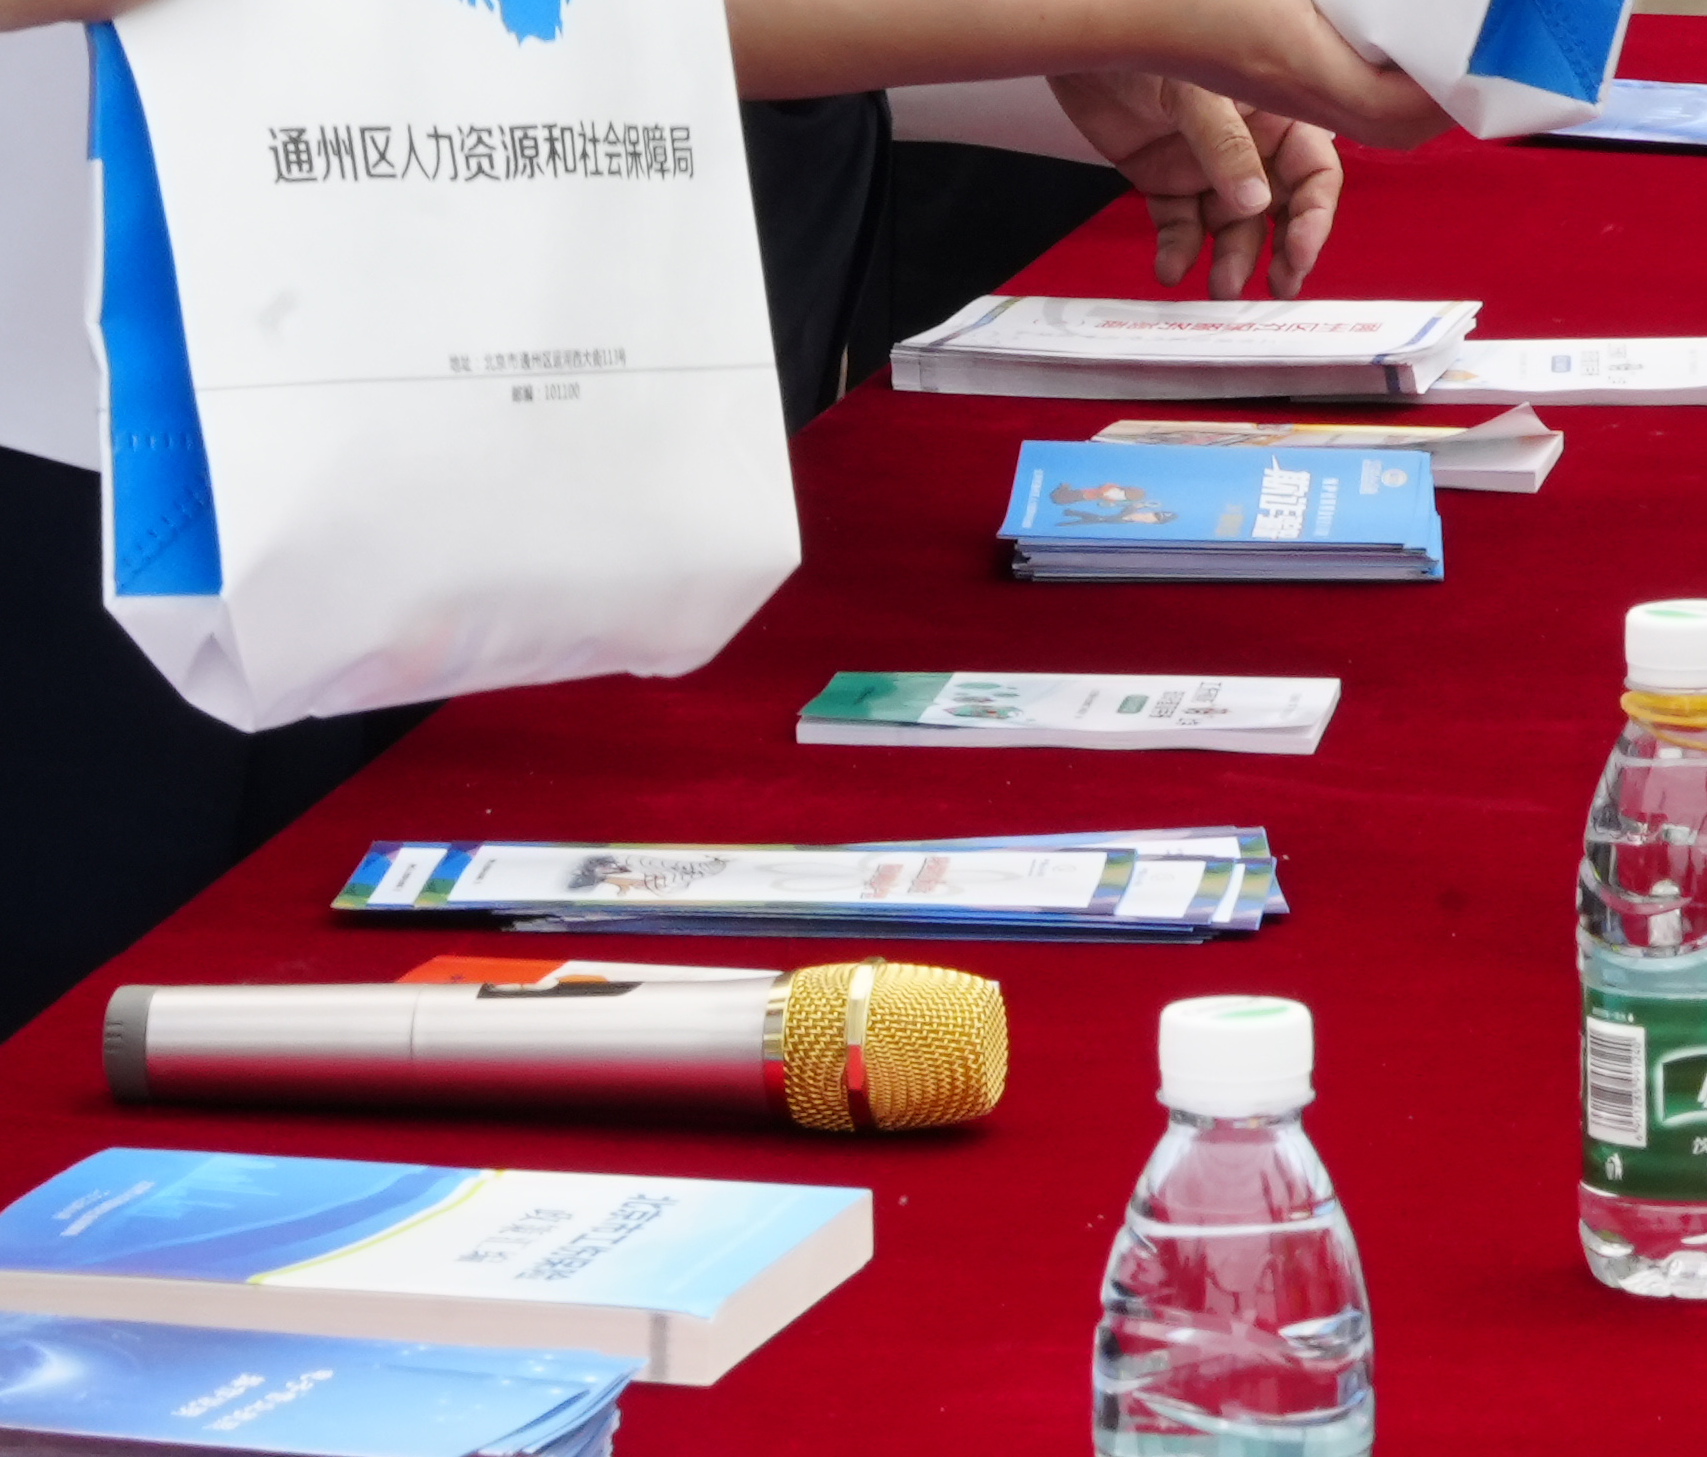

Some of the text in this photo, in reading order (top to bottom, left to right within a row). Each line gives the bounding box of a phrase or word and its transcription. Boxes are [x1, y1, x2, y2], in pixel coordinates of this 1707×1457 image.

[267, 121, 695, 183] 通州区人力资源和社会保障局
